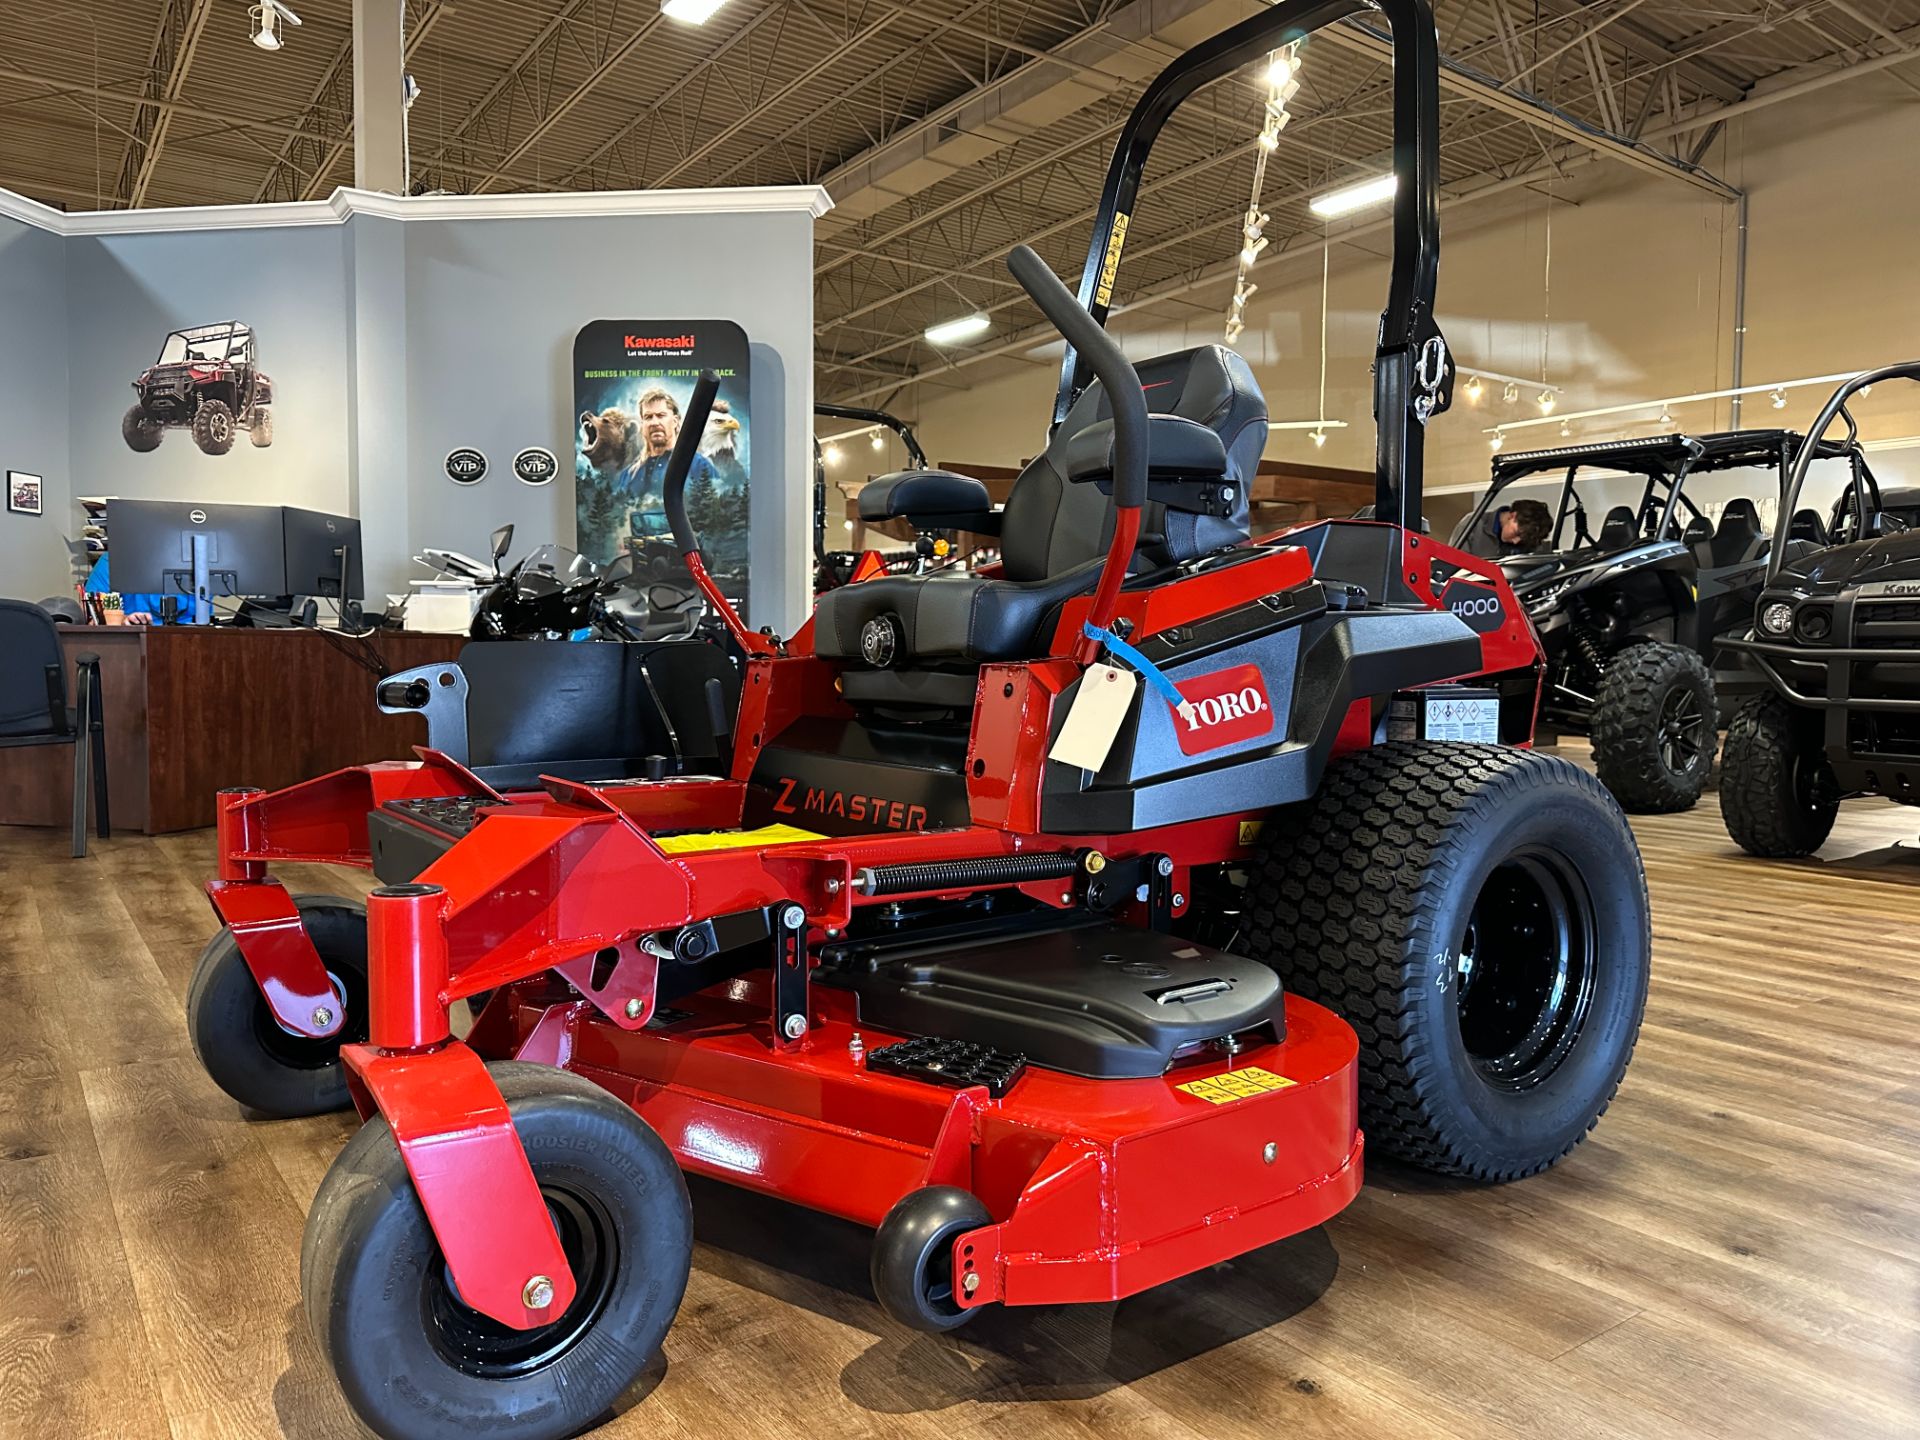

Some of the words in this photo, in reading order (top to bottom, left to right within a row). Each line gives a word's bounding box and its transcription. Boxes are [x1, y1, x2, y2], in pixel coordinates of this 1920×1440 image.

[624, 335, 695, 348] Kawasaki
[584, 370, 618, 378] BUSINESS
[619, 370, 628, 378] IN
[628, 369, 641, 377] THE
[668, 369, 690, 377] PARTY
[691, 369, 699, 377] IN
[454, 463, 477, 472] VIP
[523, 463, 547, 472] VIP
[1451, 597, 1499, 617] 4000
[773, 777, 797, 814] Z
[804, 787, 928, 831] MASTER
[602, 1148, 650, 1197] WHEEL
